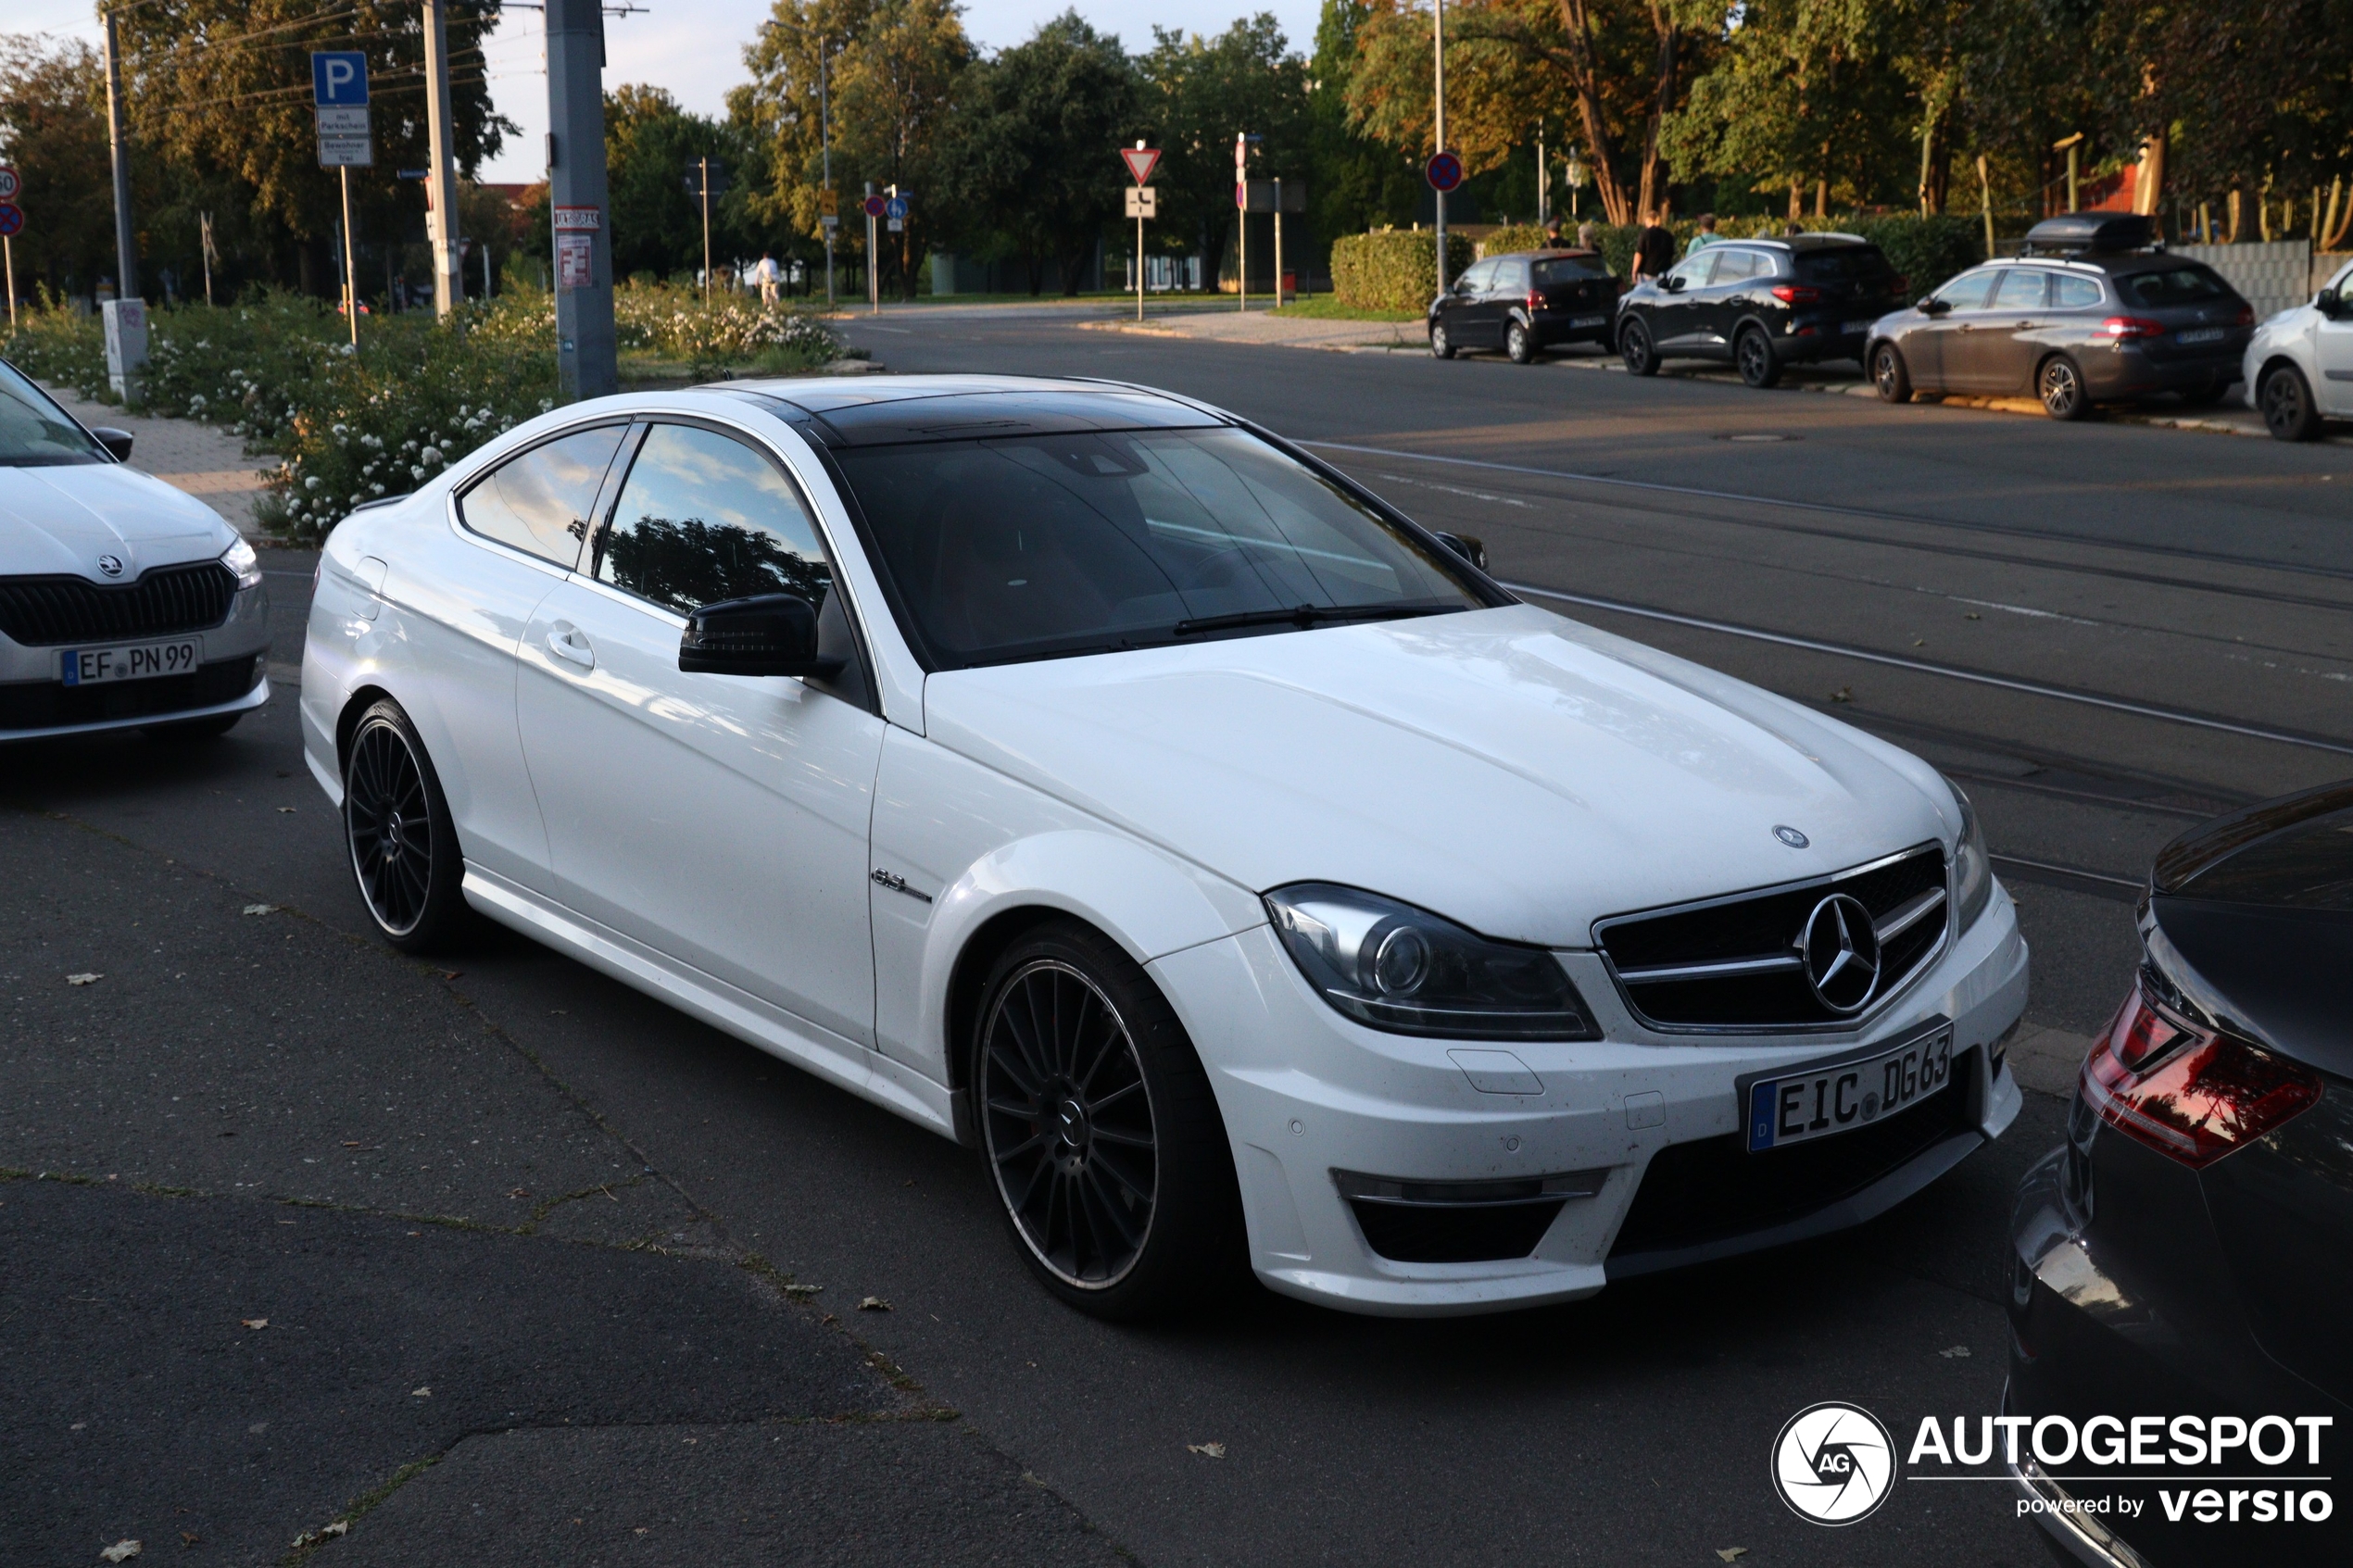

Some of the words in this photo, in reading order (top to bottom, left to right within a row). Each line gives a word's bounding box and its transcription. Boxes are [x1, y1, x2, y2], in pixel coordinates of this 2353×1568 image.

[325, 58, 355, 100] P
[321, 121, 367, 131] Parkschein
[1779, 1073, 1858, 1136] EIC
